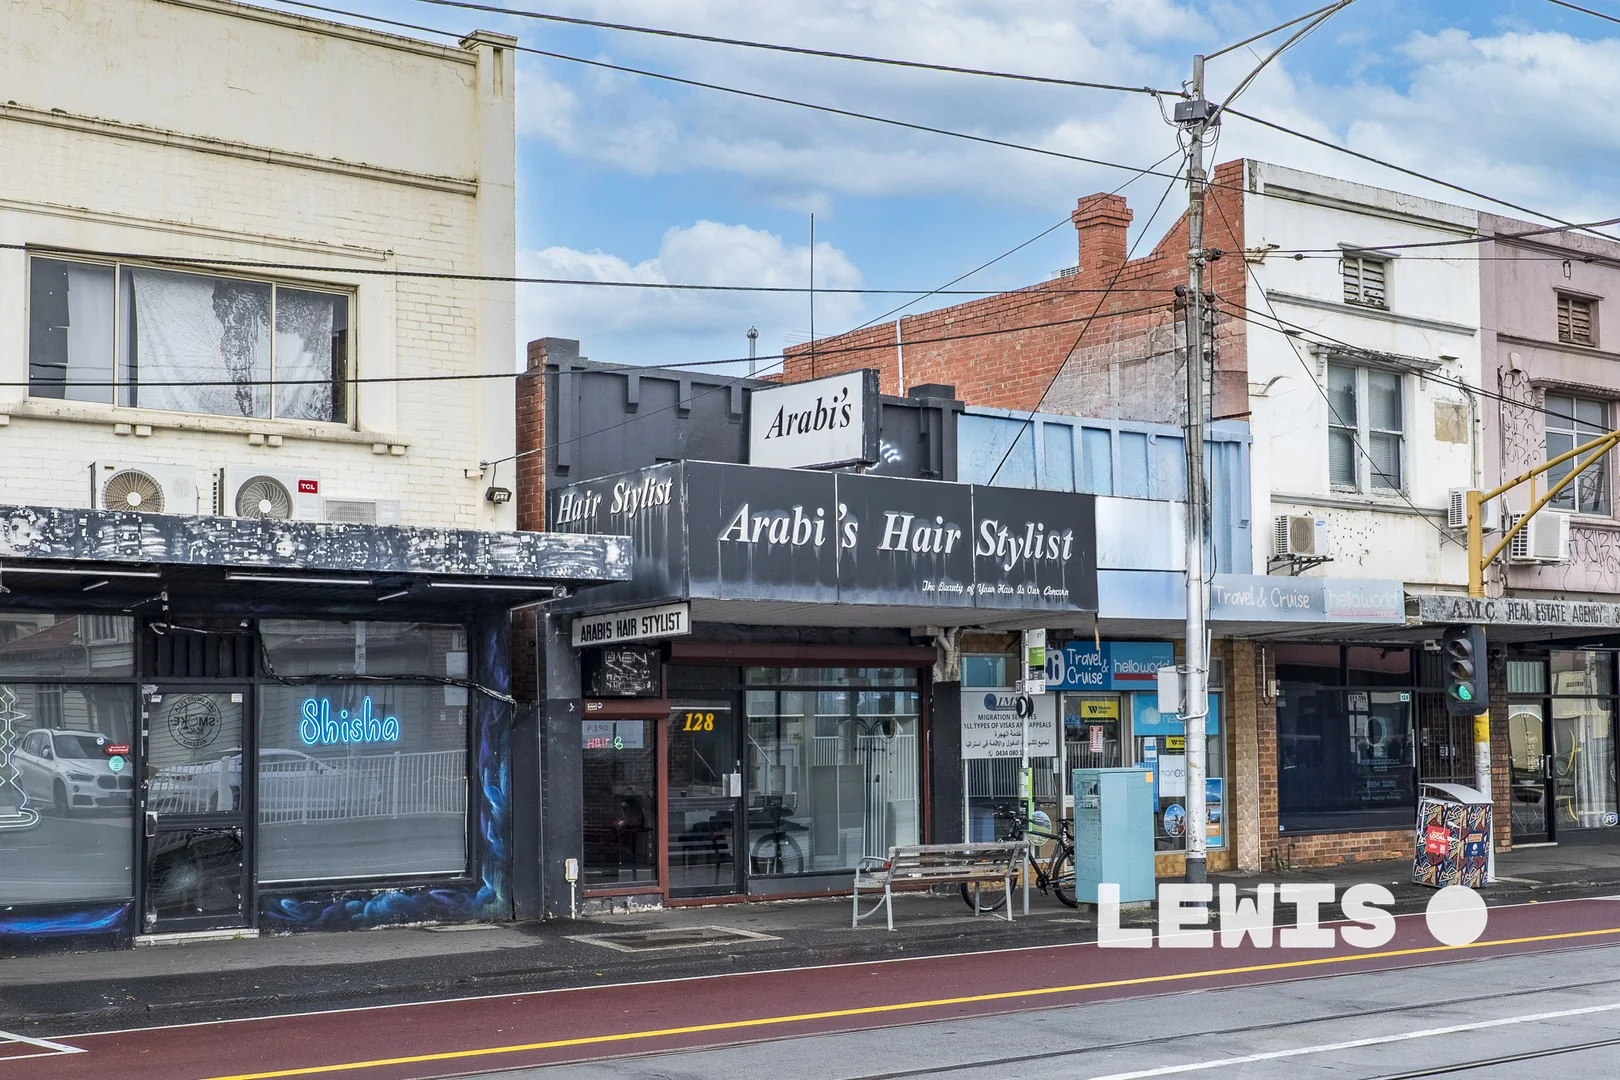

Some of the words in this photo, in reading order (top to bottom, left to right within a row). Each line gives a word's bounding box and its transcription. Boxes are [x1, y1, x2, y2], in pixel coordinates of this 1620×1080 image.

[765, 386, 853, 440] Arabi's
[301, 483, 316, 491] TCL
[556, 490, 602, 525] Hair
[610, 476, 674, 519] Stylist
[719, 503, 859, 549] Arabi's
[877, 510, 962, 554] Hair
[976, 519, 1074, 572] Stylist
[922, 580, 936, 592] The
[938, 582, 964, 595] Beauty
[966, 583, 976, 596] of
[977, 584, 996, 596] Your
[997, 584, 1014, 595] Hair
[1017, 584, 1025, 595] Is
[1027, 584, 1040, 595] Our
[1043, 585, 1070, 597] Concern
[1213, 585, 1255, 607] Travel
[1256, 587, 1268, 608] &
[1270, 588, 1311, 609] Cruise
[1327, 589, 1400, 609] helloworld
[1450, 600, 1498, 623] A.M.C.
[1507, 602, 1531, 622] REAL
[1535, 603, 1566, 623] ESTATE
[1572, 604, 1603, 624] AGENCY
[616, 617, 638, 638] HAIR
[641, 611, 682, 635] STYLIST
[1066, 648, 1102, 666] Travel
[1101, 659, 1109, 673] &
[1066, 667, 1103, 685] Cruise
[300, 695, 400, 745] Shisha
[682, 712, 715, 731] 128
[977, 713, 1011, 721] MIGRATION
[995, 749, 1008, 757] 0434
